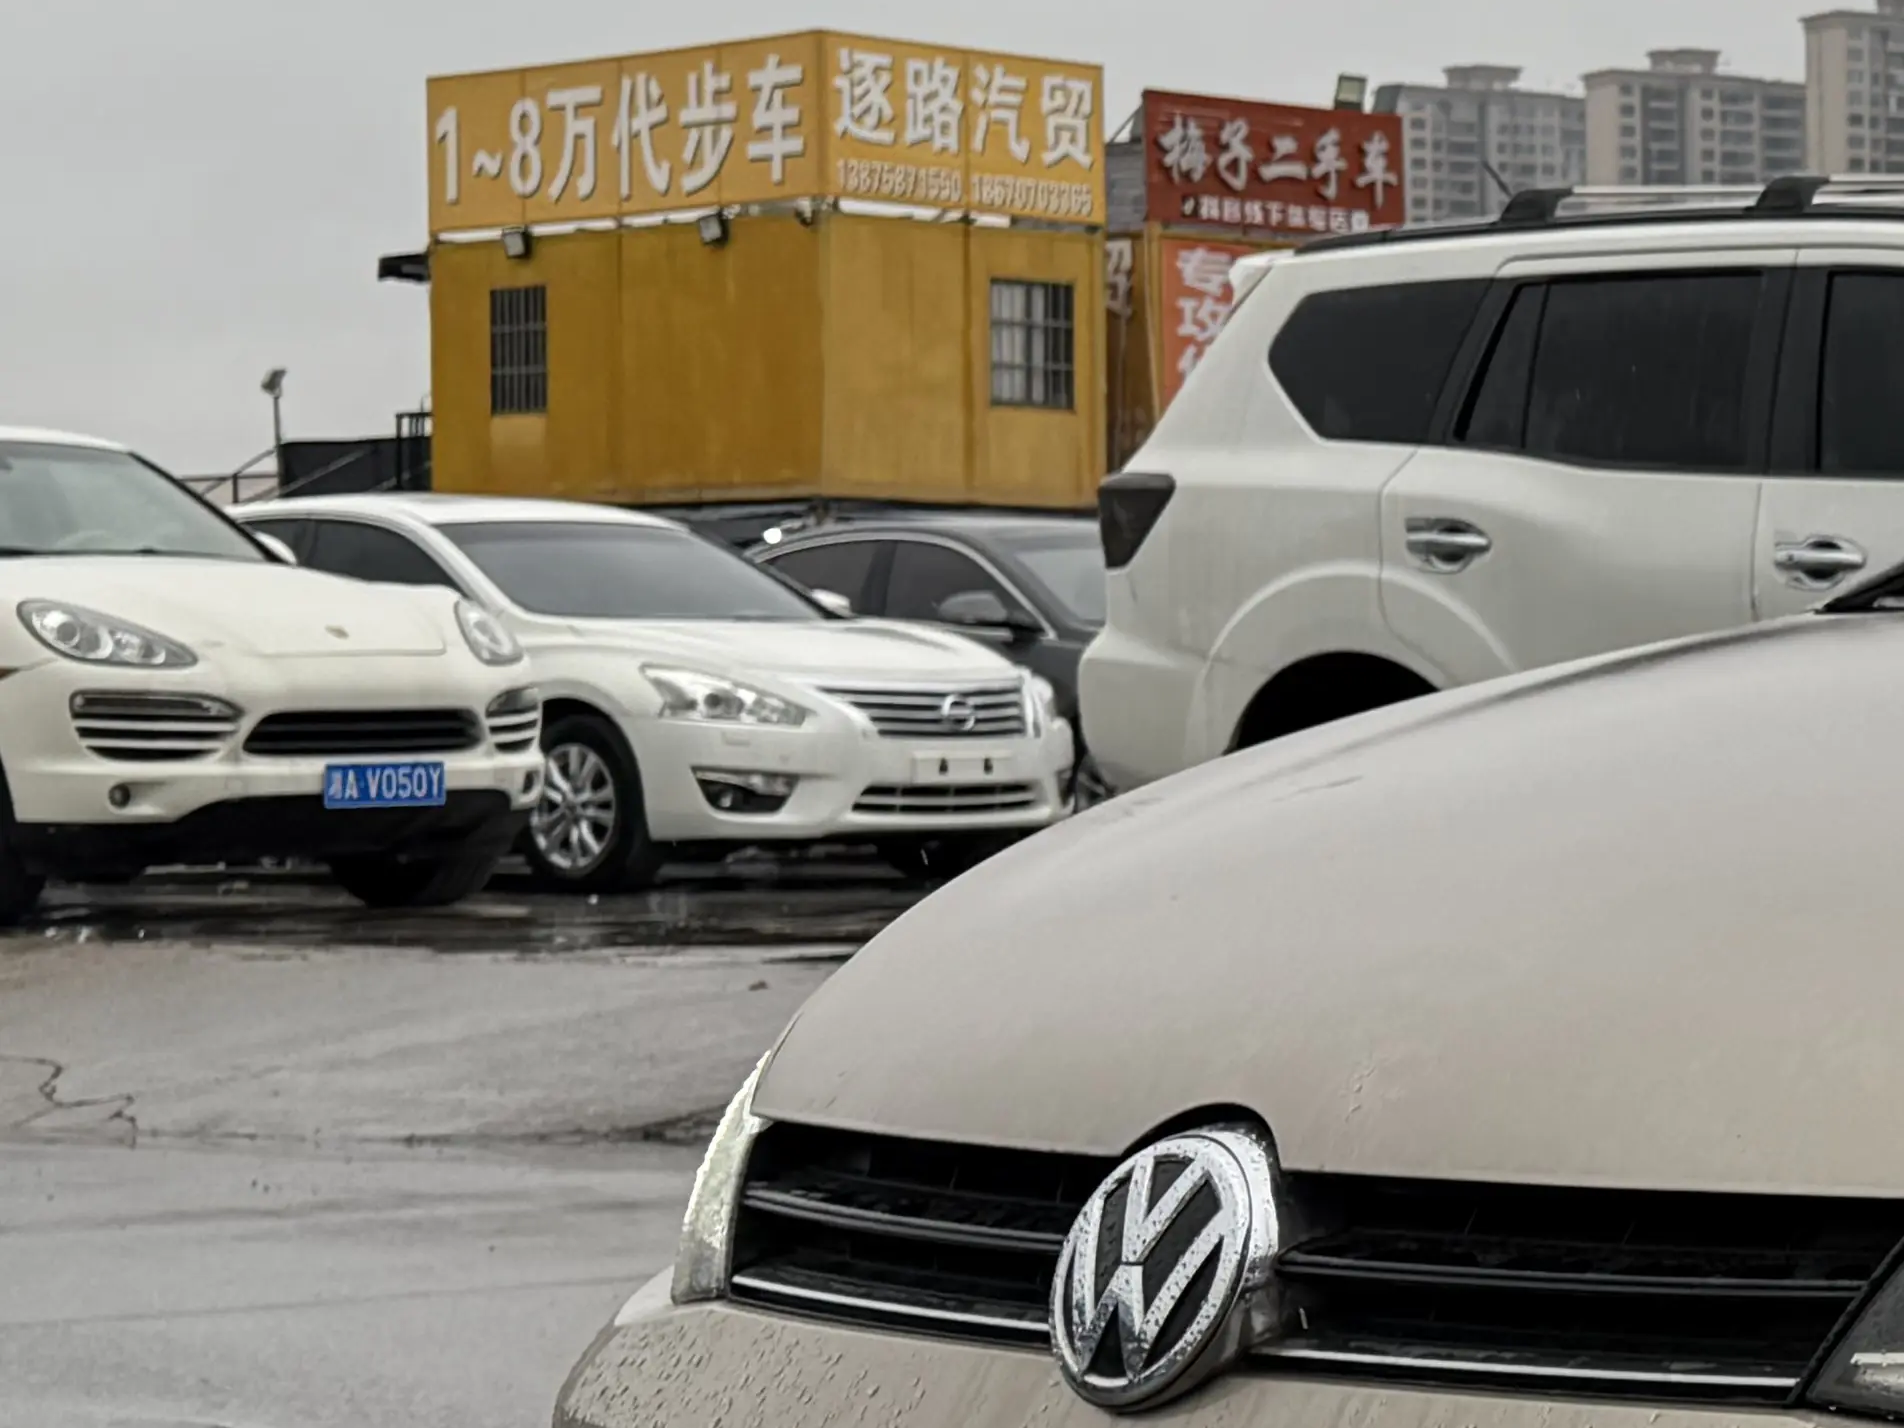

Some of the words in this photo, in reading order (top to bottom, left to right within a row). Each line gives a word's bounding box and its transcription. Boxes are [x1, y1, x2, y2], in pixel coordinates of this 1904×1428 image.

[436, 54, 804, 203] 1~8万代步车
[834, 47, 1093, 171] 逐路汽贸
